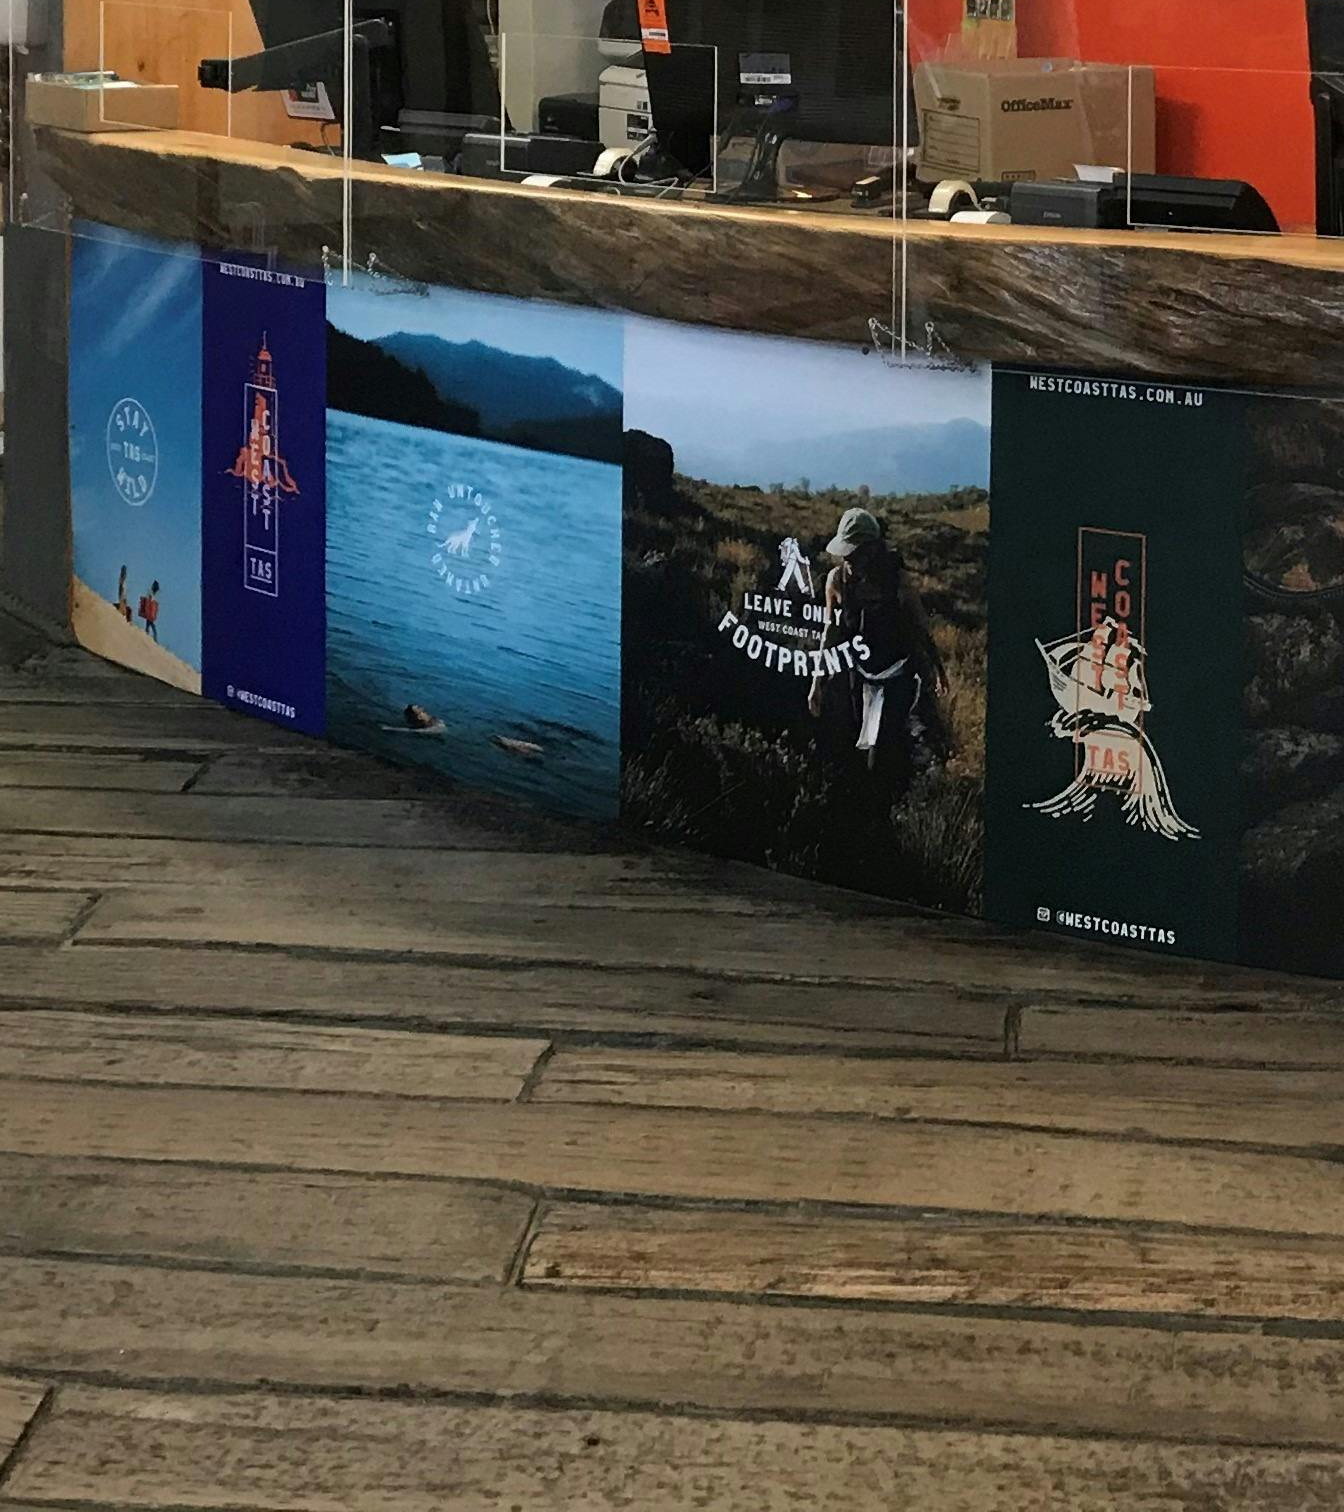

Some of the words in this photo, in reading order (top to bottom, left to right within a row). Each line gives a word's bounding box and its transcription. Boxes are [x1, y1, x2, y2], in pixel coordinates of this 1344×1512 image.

[1001, 97, 1074, 113] OfficeMax
[1029, 374, 1205, 408] WESTCOASTTAS.COM.AU
[116, 406, 149, 437] STAY
[262, 409, 271, 531] COAST
[447, 483, 502, 567] UNTOUCHED
[250, 557, 272, 580] TAS
[744, 592, 793, 618] LEAVE
[802, 603, 843, 627] ONLY
[717, 610, 871, 677] FOOTPRINTS
[758, 620, 781, 633] WEST
[782, 624, 809, 638] COAST
[1115, 559, 1132, 712] COAST
[1087, 744, 1130, 772] TAS
[1057, 909, 1176, 945] @WESTCOASTTAS
